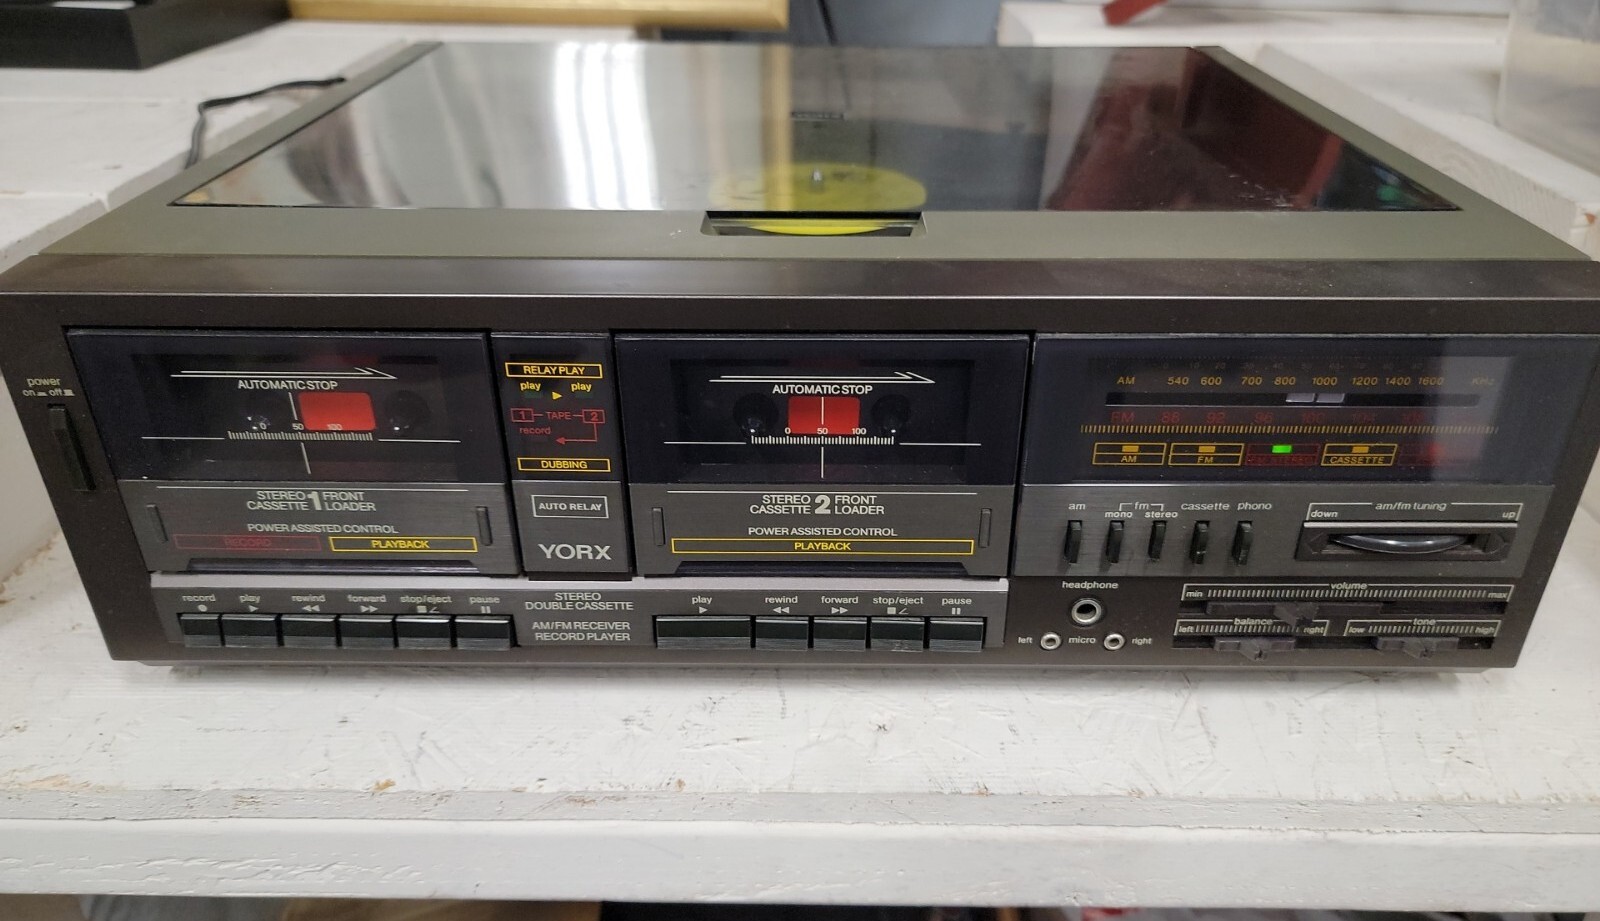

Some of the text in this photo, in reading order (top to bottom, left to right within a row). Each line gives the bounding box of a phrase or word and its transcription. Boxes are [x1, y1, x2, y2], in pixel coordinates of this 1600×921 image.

[523, 365, 585, 376] RELAY PLAY
[26, 378, 61, 387] power
[237, 379, 339, 390] AUTOMATIC STOP
[1116, 376, 1135, 385] AM
[1167, 376, 1190, 386] 540
[1200, 376, 1222, 386] 600
[1241, 376, 1263, 386] 700
[1274, 376, 1296, 386] 800
[1312, 376, 1338, 386] 1000
[1352, 376, 1378, 386] 1200
[1385, 376, 1411, 386] 1400
[1418, 376, 1445, 386] 1600
[520, 381, 592, 393] play play
[772, 384, 873, 395] AUTOMATIC STOP
[22, 388, 63, 397] on off
[519, 410, 599, 421] 1 TAPE 2
[1111, 412, 1135, 423] FM
[1161, 412, 1181, 423] 88
[1206, 412, 1226, 423] 92
[259, 422, 267, 430] 0
[292, 423, 304, 431] 50
[519, 425, 551, 434] record
[784, 427, 867, 435] 0 50 100
[1120, 455, 1214, 464] AM FM
[1329, 456, 1385, 465] CASSETTE
[541, 460, 588, 470] DUBBING
[256, 490, 365, 502] STEREO FRONT
[307, 491, 322, 511] 1
[762, 494, 877, 505] STEREO FRONT
[247, 501, 376, 512] CASSETTE LOADER
[538, 502, 602, 511] AUTO RELAY
[814, 494, 831, 515] 2
[1068, 503, 1086, 511] am
[1134, 502, 1149, 510] fm
[1181, 502, 1230, 511] cassette
[1237, 502, 1272, 511] phono
[1375, 501, 1447, 512] am/fm tuning
[749, 505, 885, 515] CASSETTE LOADER
[1144, 510, 1178, 518] stereo
[1311, 508, 1338, 519] down
[1502, 510, 1516, 520] up
[247, 523, 399, 534] POWER ASSISTED CONTROL
[748, 527, 898, 537] POWER ASSISTED CONTROL
[224, 538, 272, 548] RECORD
[371, 539, 430, 549] PLAYBACK
[794, 542, 851, 551] PLAYBACK
[538, 543, 611, 560] YORX
[1062, 581, 1119, 591] headphone
[1330, 582, 1367, 590] volume
[182, 593, 216, 603] record
[239, 593, 261, 605] play
[292, 593, 326, 603] rewind
[347, 594, 386, 603] forward
[554, 592, 602, 601] STEREO
[1186, 590, 1203, 598] min
[1488, 591, 1507, 599] max
[400, 594, 452, 605] stop/eject
[469, 596, 500, 606] pause
[692, 595, 713, 605] play
[764, 595, 798, 604] rewind
[821, 595, 859, 604] forward
[872, 595, 924, 606] stop/eject
[941, 597, 972, 606] pause
[525, 601, 634, 611] DOUBLE CASSETTE
[532, 621, 631, 631] AM/FM RECEIVER
[1234, 617, 1274, 626] balance
[1413, 618, 1436, 626] tone
[1179, 625, 1194, 633] left
[1303, 626, 1325, 634] right
[1349, 626, 1366, 634] low
[1474, 626, 1495, 635] high
[535, 632, 631, 642] RECORD PLAYER
[1017, 636, 1032, 645] left
[1068, 635, 1096, 645] micro
[1131, 636, 1153, 648] right
